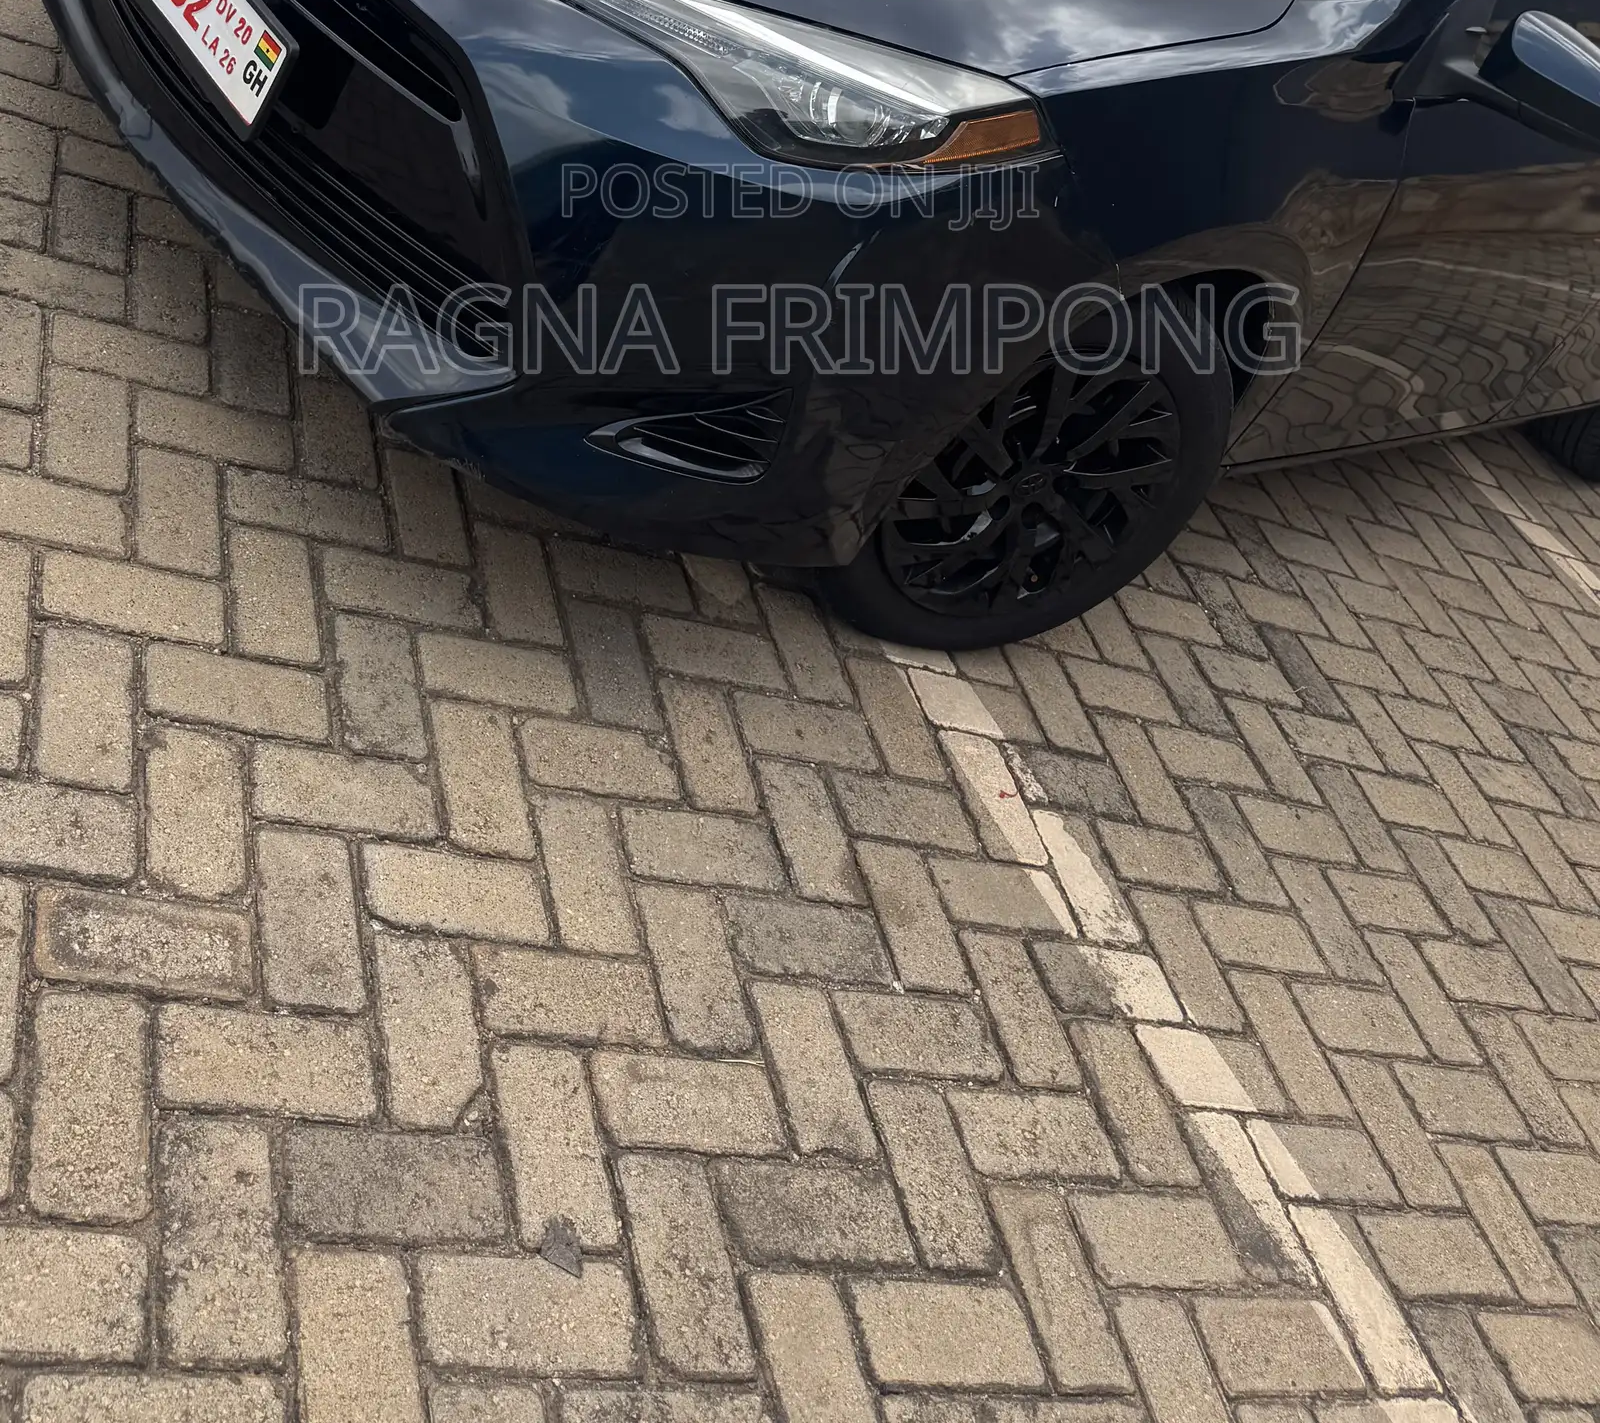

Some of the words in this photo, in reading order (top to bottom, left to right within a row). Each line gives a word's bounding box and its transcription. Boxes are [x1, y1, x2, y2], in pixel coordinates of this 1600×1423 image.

[233, 17, 253, 45] 20
[201, 25, 220, 56] LA
[219, 49, 236, 75] 26
[242, 60, 268, 97] GH
